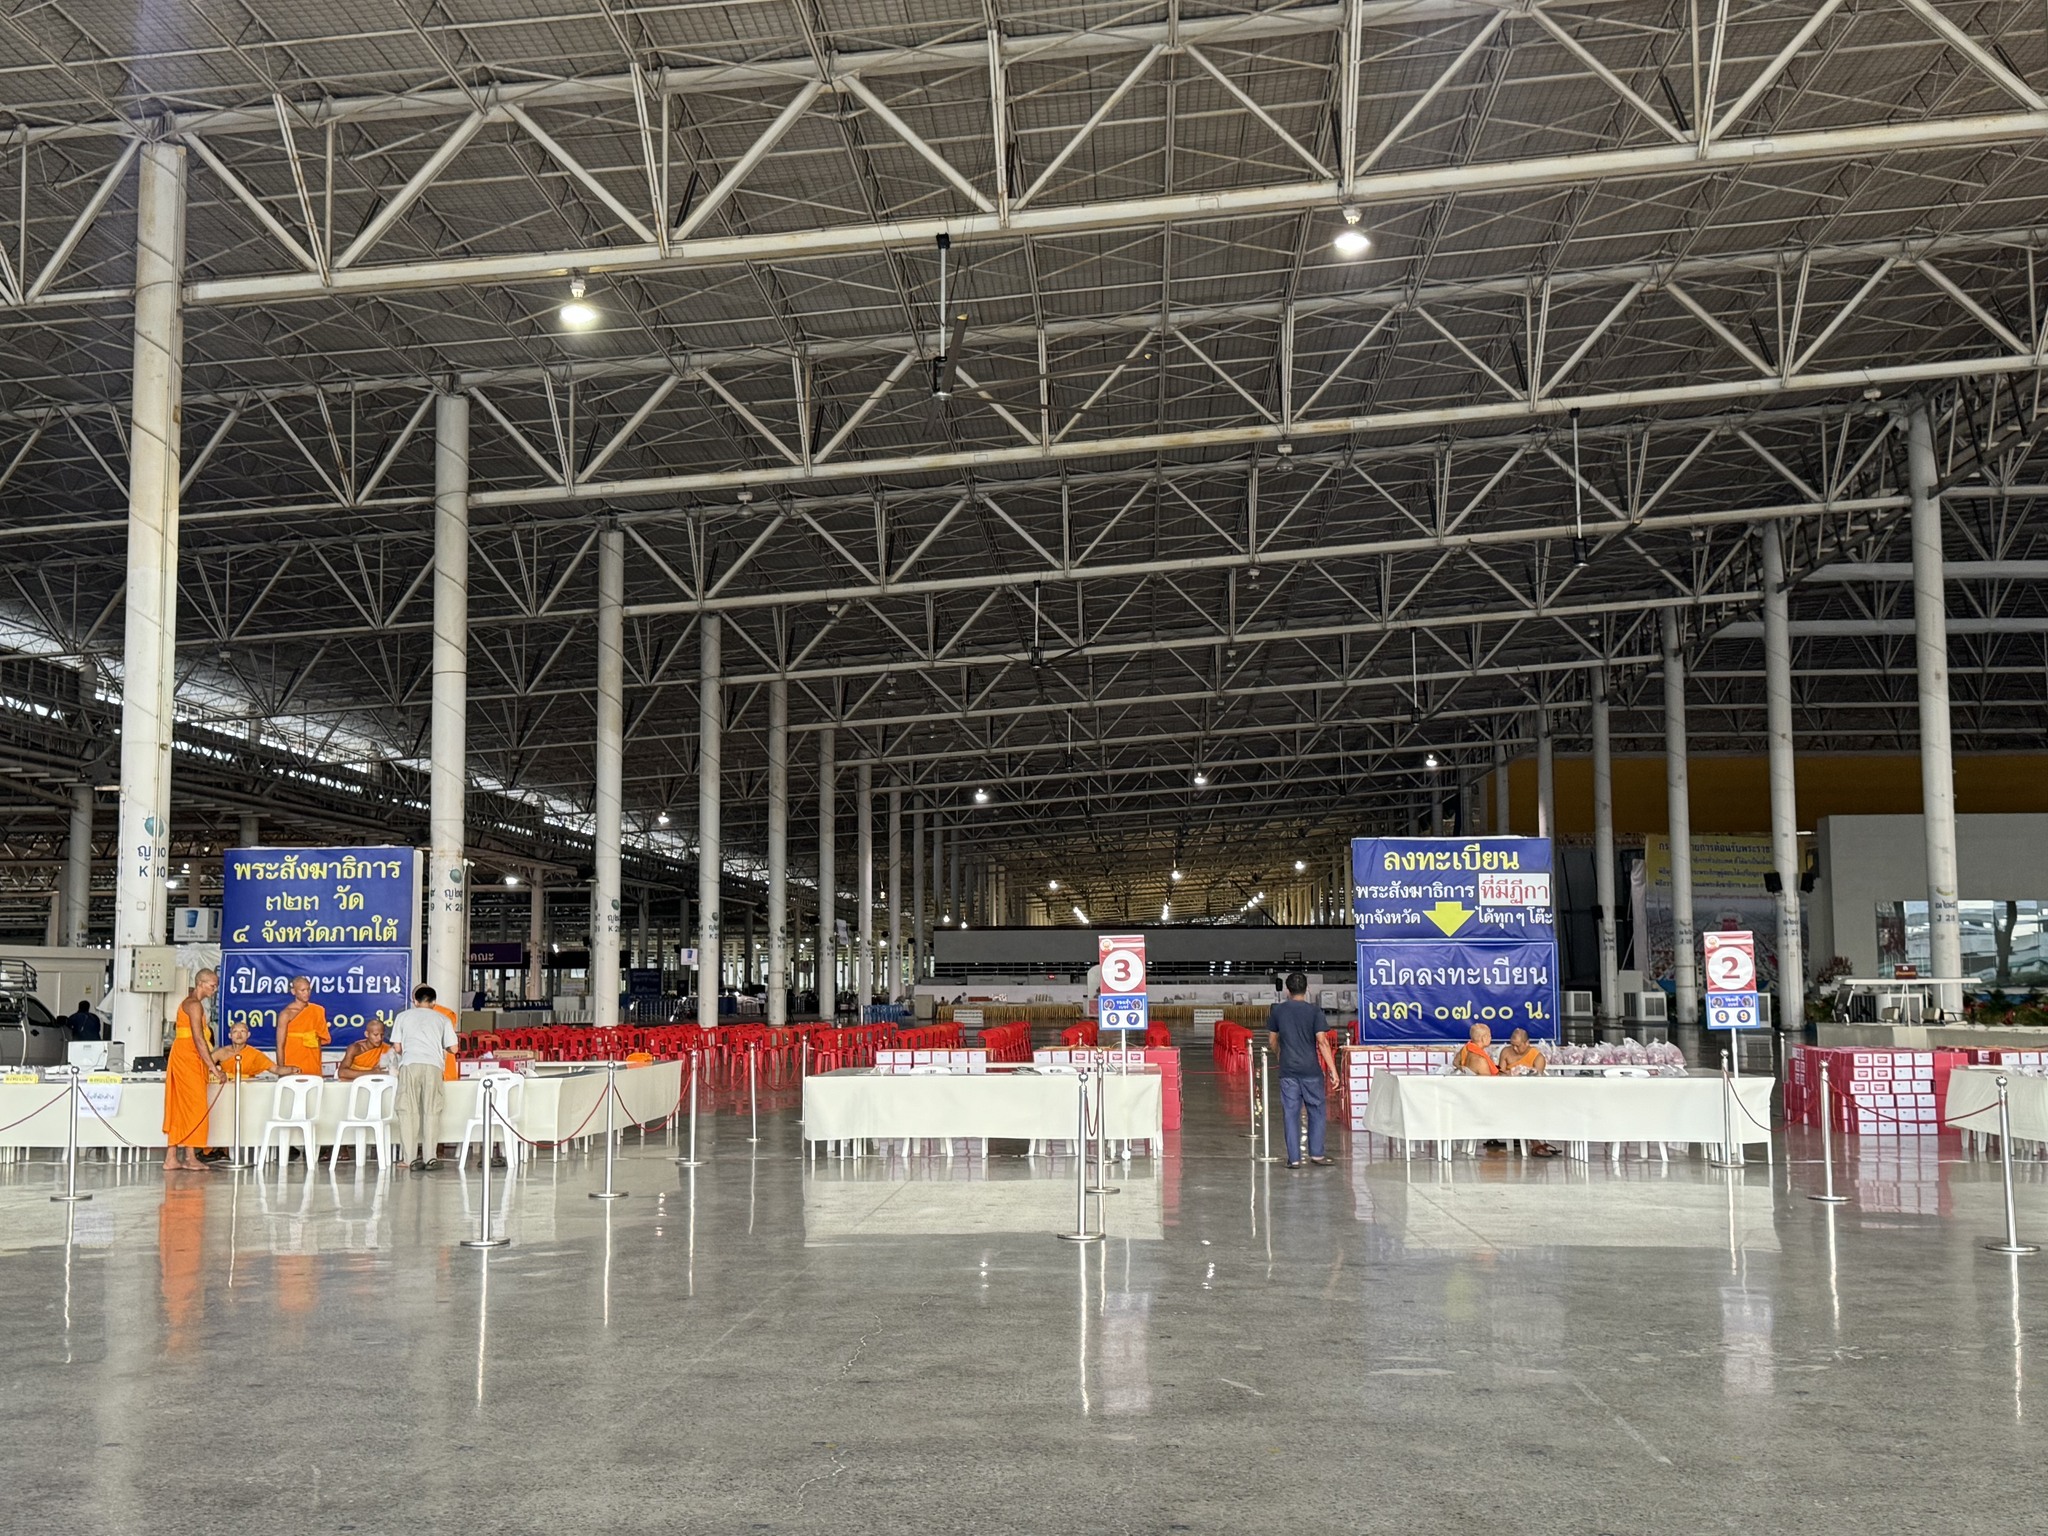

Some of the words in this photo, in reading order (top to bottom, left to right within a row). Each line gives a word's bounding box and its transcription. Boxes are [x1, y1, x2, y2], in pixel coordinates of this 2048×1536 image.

[234, 854, 402, 880] พระสังฆาธิการ
[1383, 843, 1520, 871] ลงทะเบียน
[265, 891, 319, 911] ๓๒๓
[333, 885, 364, 910] วัด
[1355, 880, 1475, 899] พระสังฆาธิการ
[232, 924, 250, 943] ๔
[261, 914, 399, 943] จังหวัดภาคใต้
[1354, 908, 1421, 930] ทุกจังหวัด
[1527, 907, 1553, 925] โต๊ะ
[1114, 959, 1131, 981] 3
[1369, 956, 1548, 986] เปิดลงทะเบียน
[1721, 956, 1741, 979] 2
[229, 965, 401, 994] เปิดลทะเบียน
[227, 1009, 276, 1027] เวลา
[1109, 1014, 1117, 1024] 6
[1129, 1014, 1137, 1024] 7
[1368, 1001, 1422, 1020] เวลา
[1434, 1000, 1514, 1020] ๐๗.๐๐
[1524, 1001, 1551, 1020] น.
[1718, 1011, 1726, 1022] 8
[1740, 1011, 1748, 1022] 9
